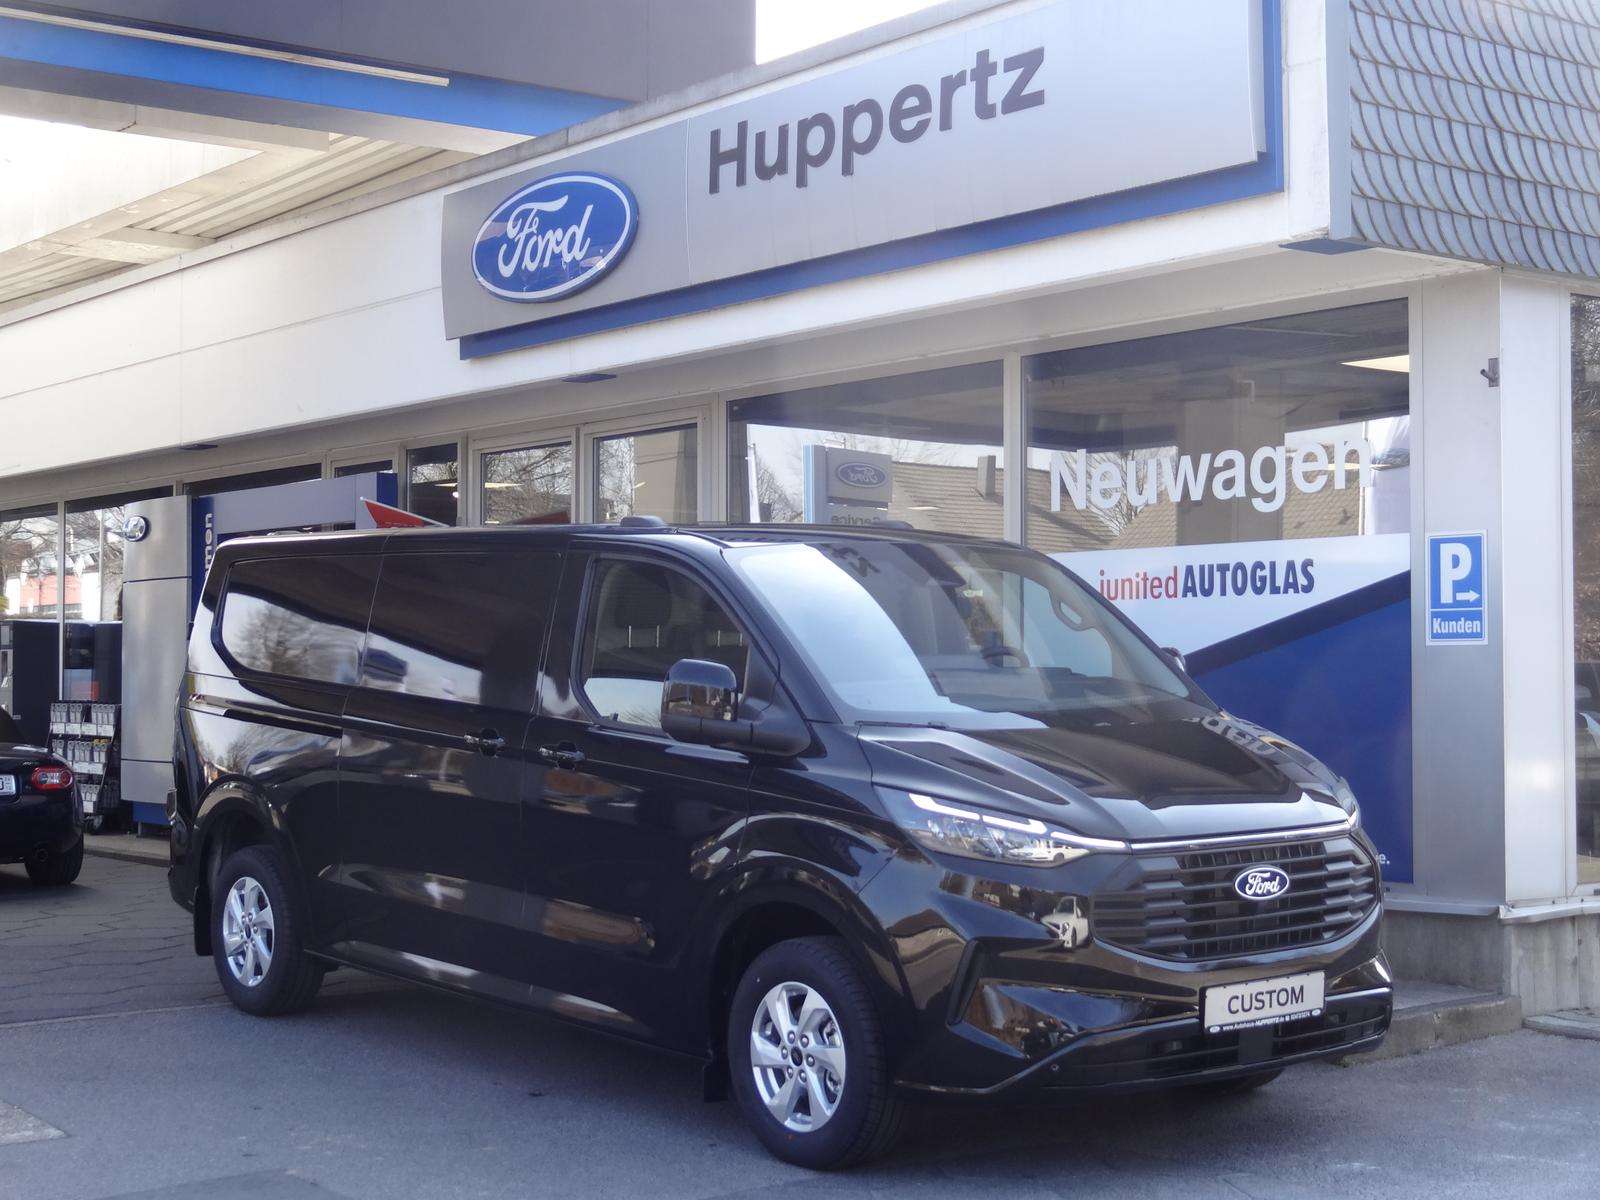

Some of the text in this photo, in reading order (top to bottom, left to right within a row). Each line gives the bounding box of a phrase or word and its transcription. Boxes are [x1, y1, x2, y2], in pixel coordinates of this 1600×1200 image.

[708, 46, 1045, 195] Huppertz
[497, 194, 594, 278] Ford
[1050, 439, 1372, 513] Neuwagen
[1181, 558, 1315, 598] AUTOGLAS
[1440, 542, 1472, 604] P
[1432, 617, 1481, 634] Kunden
[1245, 872, 1281, 894] Ford
[1227, 985, 1304, 1014] CUSTOM
